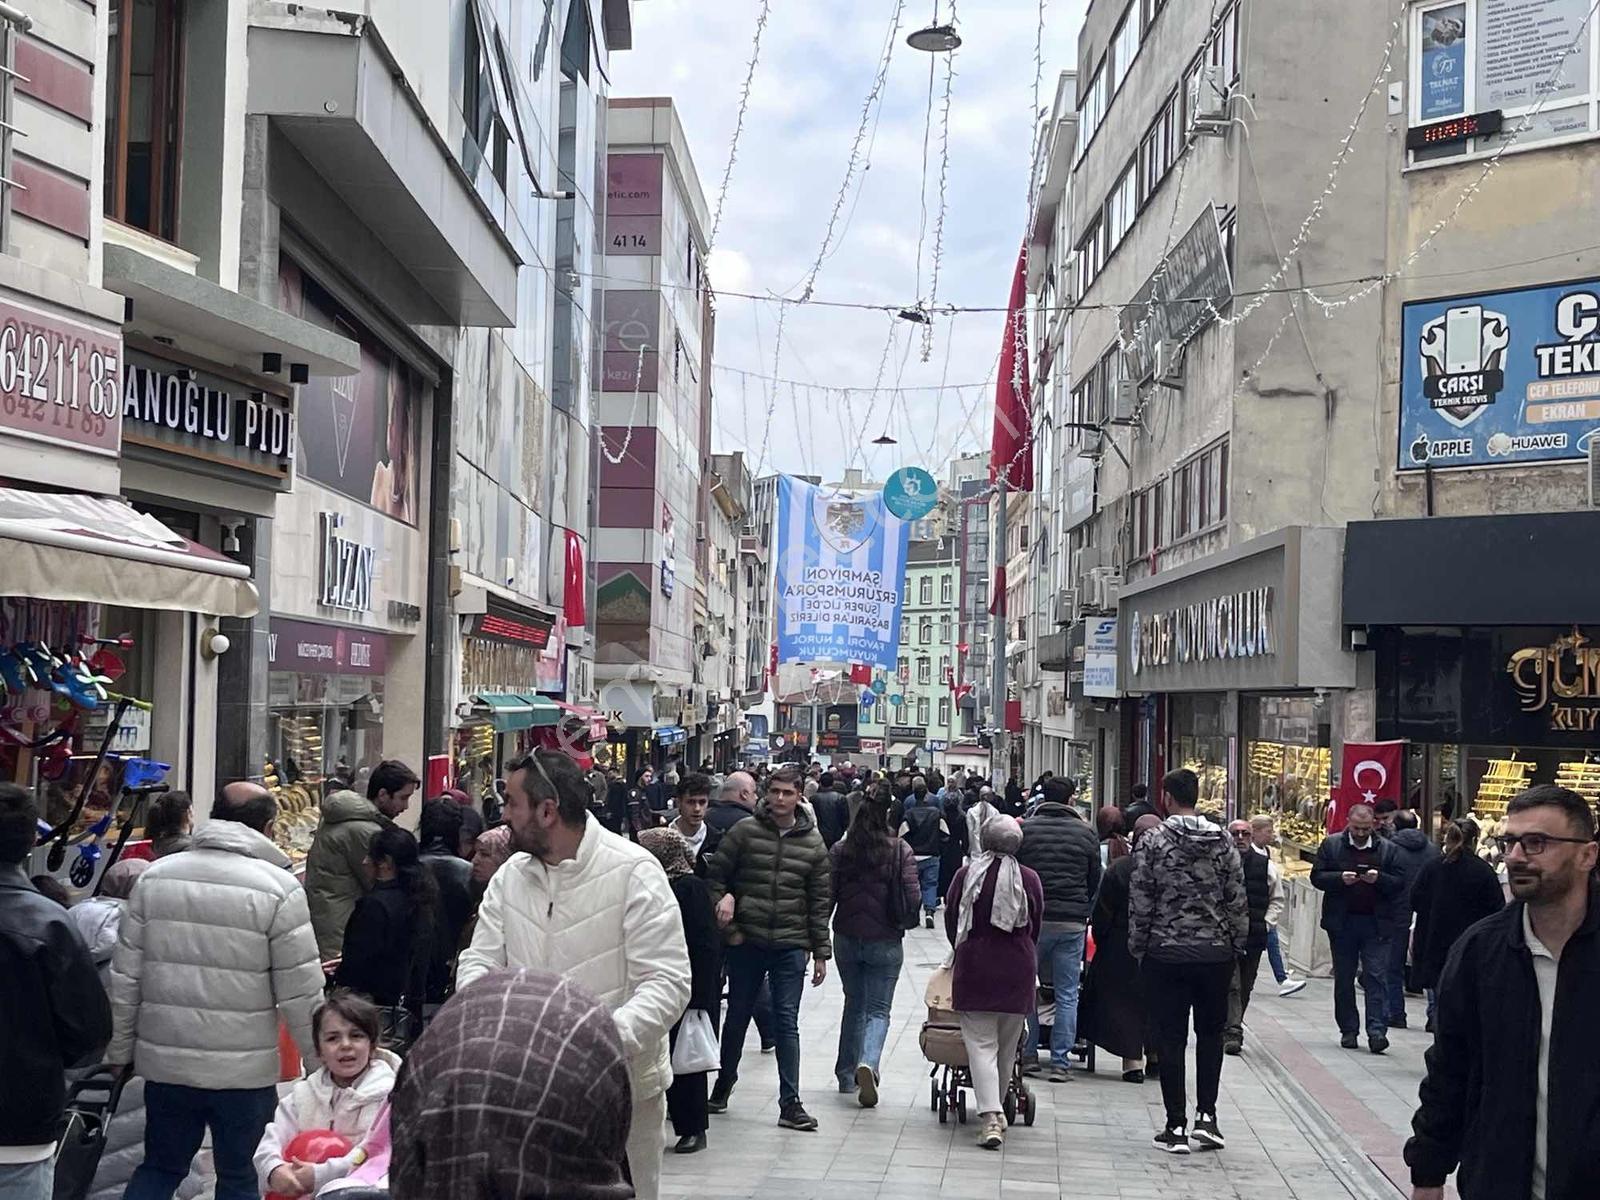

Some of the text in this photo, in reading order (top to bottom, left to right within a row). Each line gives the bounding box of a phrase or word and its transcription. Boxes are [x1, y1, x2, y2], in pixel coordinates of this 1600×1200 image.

[613, 235, 646, 247] 41 14
[1438, 374, 1484, 398] ÇARŞI
[1529, 380, 1600, 398] CEP TELEFONU
[123, 364, 230, 442] ANOĞLU
[1541, 403, 1586, 421] EKRAN
[1432, 439, 1472, 456] APPLE
[1511, 434, 1567, 449] HUAWEI
[1174, 586, 1275, 663] KUYUMCULUK
